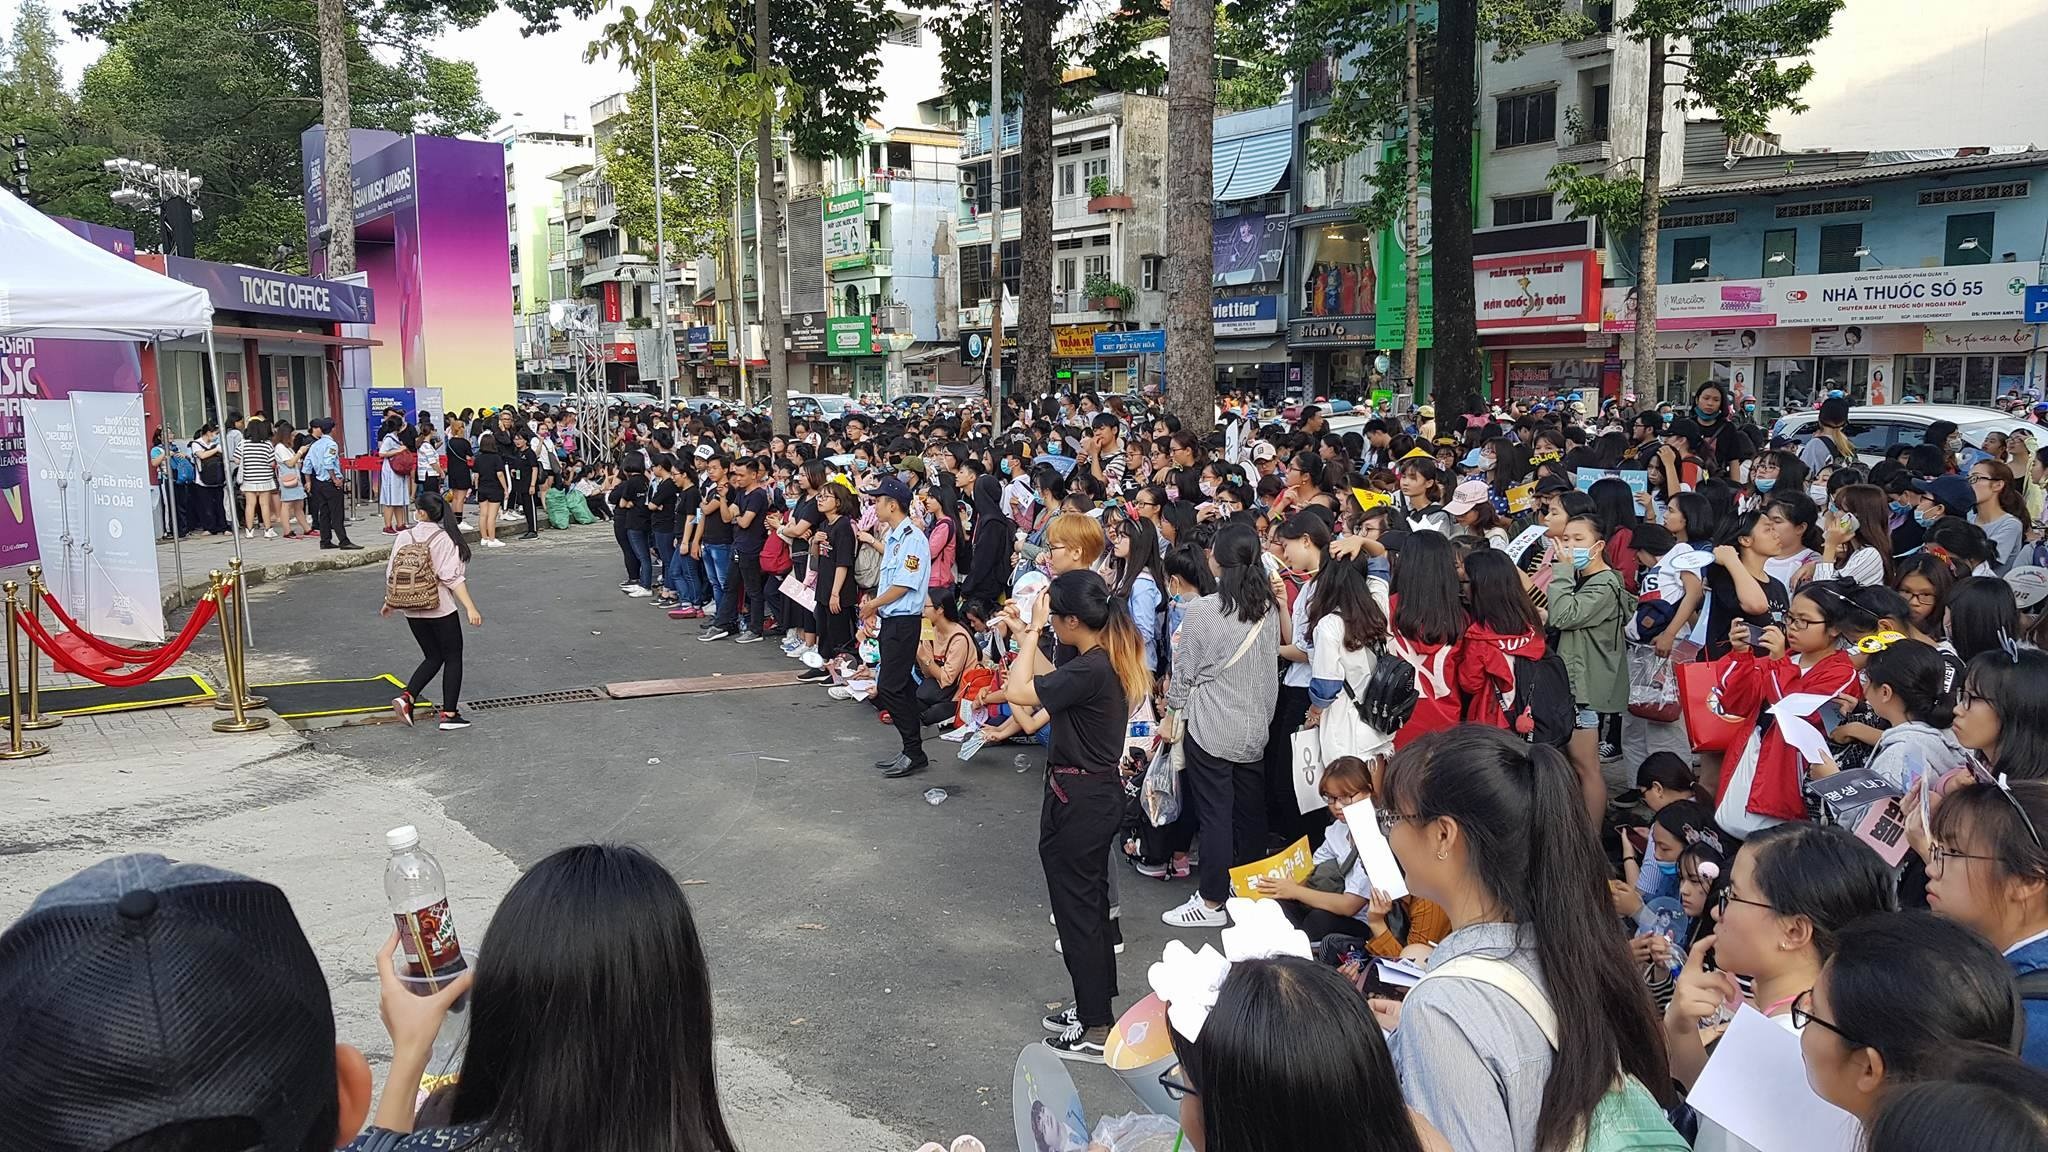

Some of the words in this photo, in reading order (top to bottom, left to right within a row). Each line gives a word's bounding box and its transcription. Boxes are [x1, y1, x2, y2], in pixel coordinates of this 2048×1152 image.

[384, 167, 410, 197] AWARDS
[240, 276, 285, 307] TICKET
[288, 283, 331, 312] OFFICE
[1823, 284, 1858, 302] NHÀ
[1864, 281, 1925, 300] THUỐC
[1931, 279, 1957, 297] SỐ
[1962, 281, 1983, 296] 55
[1213, 303, 1256, 318] viettien
[2035, 301, 2048, 313] P
[1300, 326, 1326, 337] Brian
